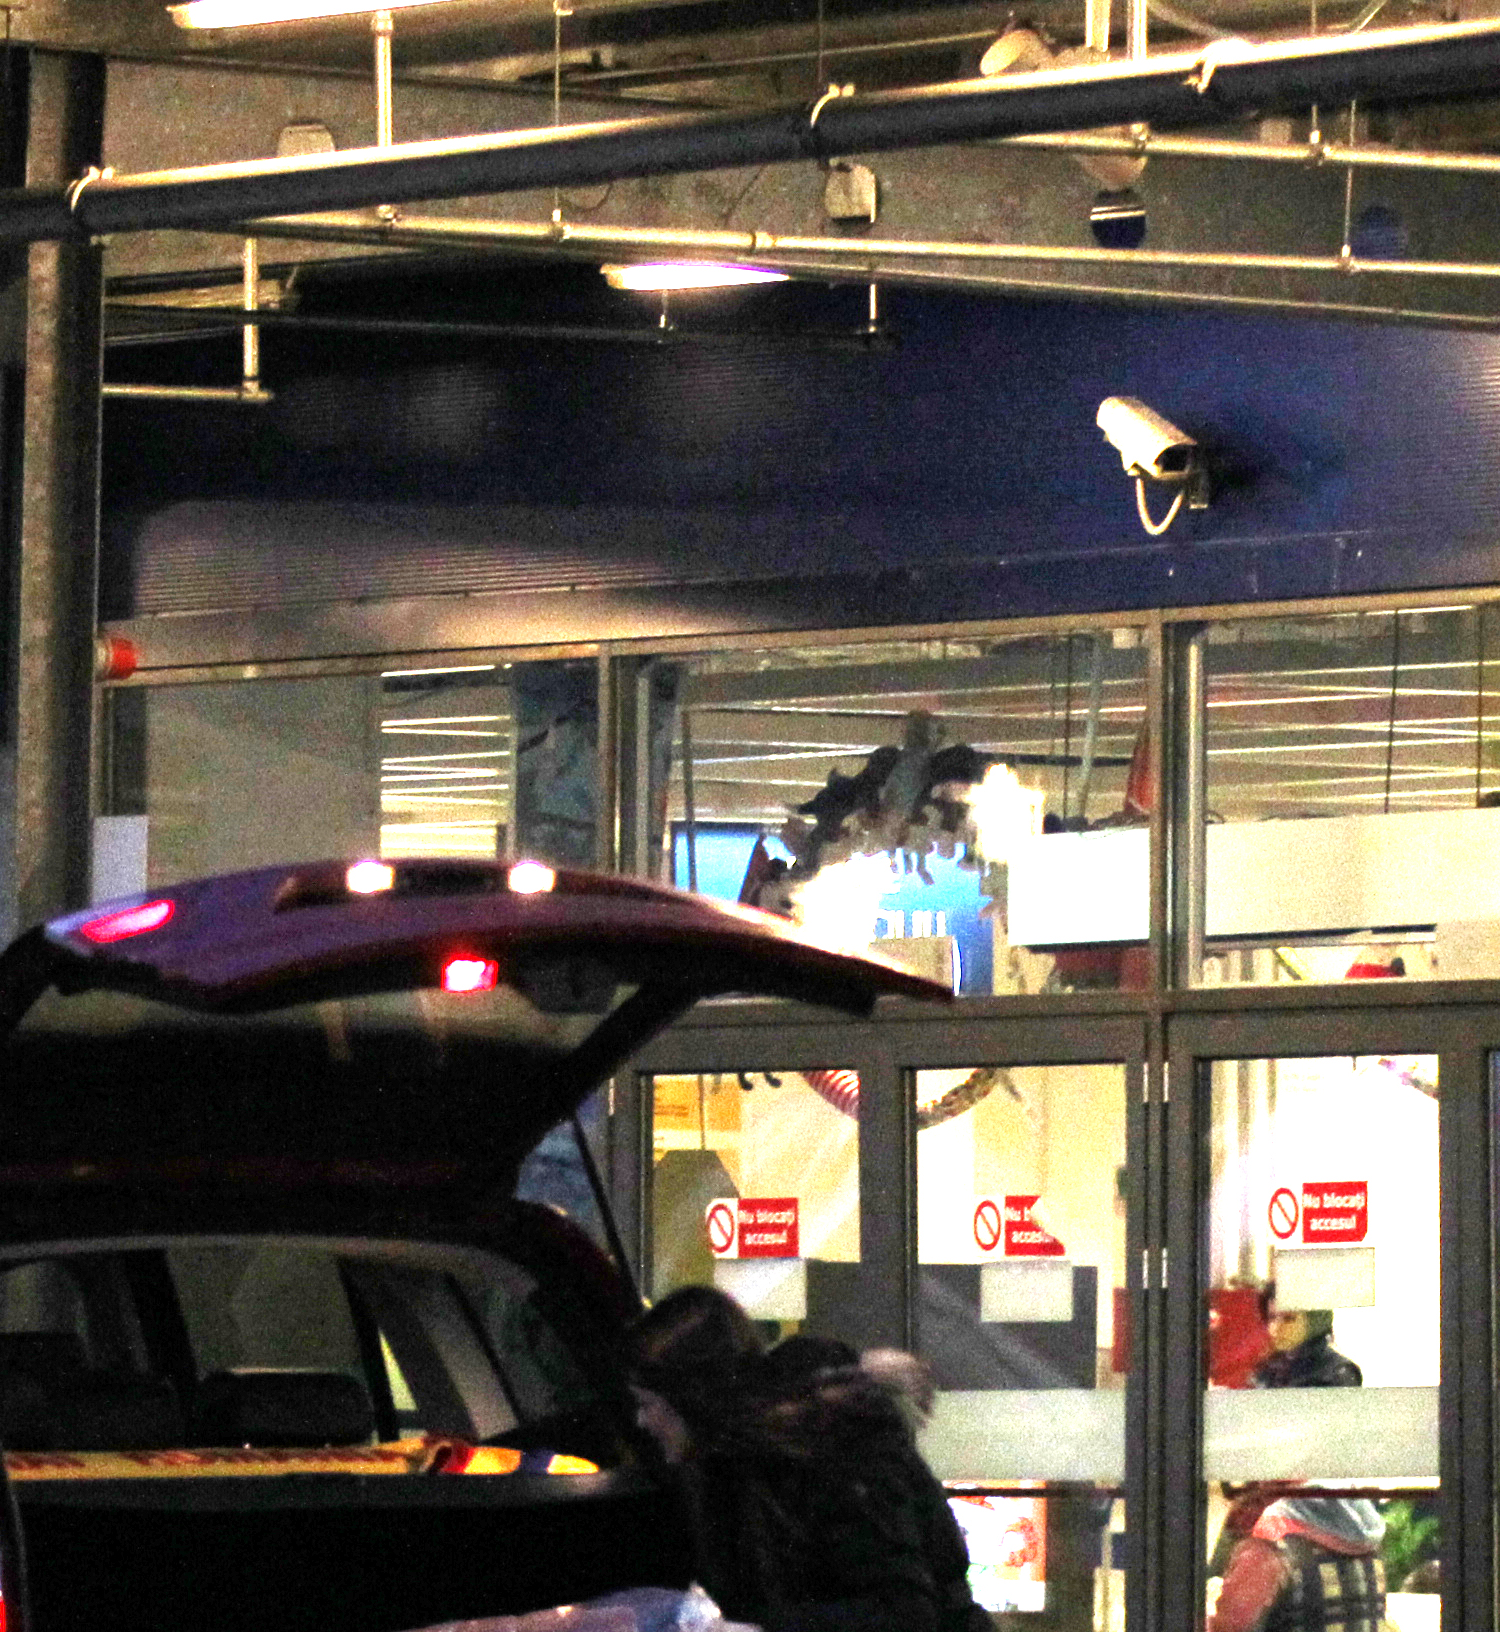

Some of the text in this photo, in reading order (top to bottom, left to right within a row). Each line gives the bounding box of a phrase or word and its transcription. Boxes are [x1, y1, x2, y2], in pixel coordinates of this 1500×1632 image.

[1302, 1193, 1320, 1209] Nu
[1310, 1215, 1356, 1231] accesul
[745, 1229, 787, 1245] accesul
[1011, 1230, 1054, 1244] acces
